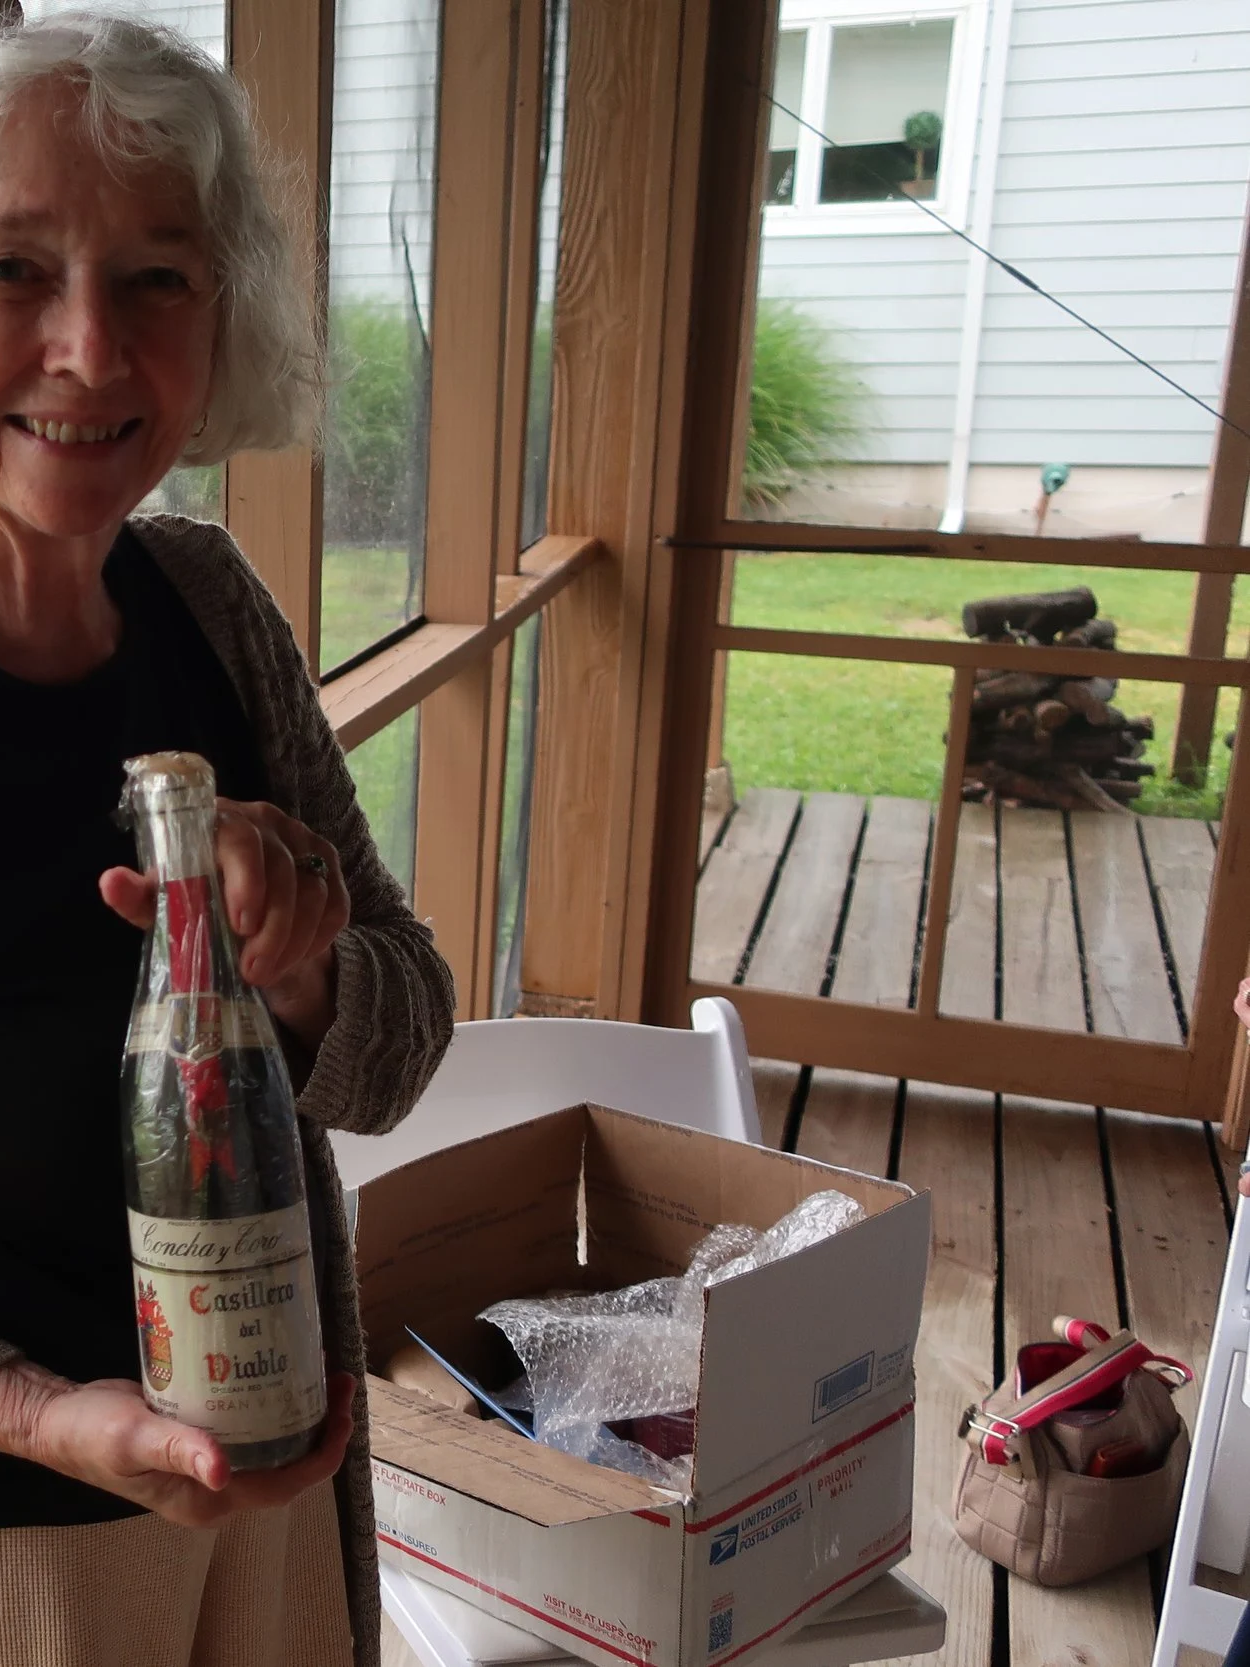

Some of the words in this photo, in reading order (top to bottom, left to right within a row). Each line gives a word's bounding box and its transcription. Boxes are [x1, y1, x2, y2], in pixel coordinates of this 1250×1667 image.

[140, 1220, 214, 1258] Concha
[214, 1245, 231, 1265] y
[234, 1218, 284, 1256] Toro
[189, 1281, 295, 1316] Casillero
[238, 1319, 263, 1338] del
[204, 1351, 289, 1384] Diablo
[205, 1399, 249, 1412] GRAN
[258, 1389, 293, 1408] VO
[247, 1383, 263, 1392] RED
[381, 1467, 401, 1484] FLAT
[403, 1478, 425, 1496] RATE
[426, 1488, 447, 1506] BOX
[816, 1457, 865, 1492] PRIORITY
[829, 1481, 854, 1499] MAIL
[741, 1504, 772, 1531] UNITED
[771, 1488, 798, 1515] STATES
[398, 1531, 439, 1557] INSURED
[739, 1525, 771, 1553] POSTAL
[770, 1507, 802, 1536] SERVICE
[543, 1593, 567, 1610] VISIT
[568, 1604, 582, 1617] US
[584, 1612, 597, 1625] AT
